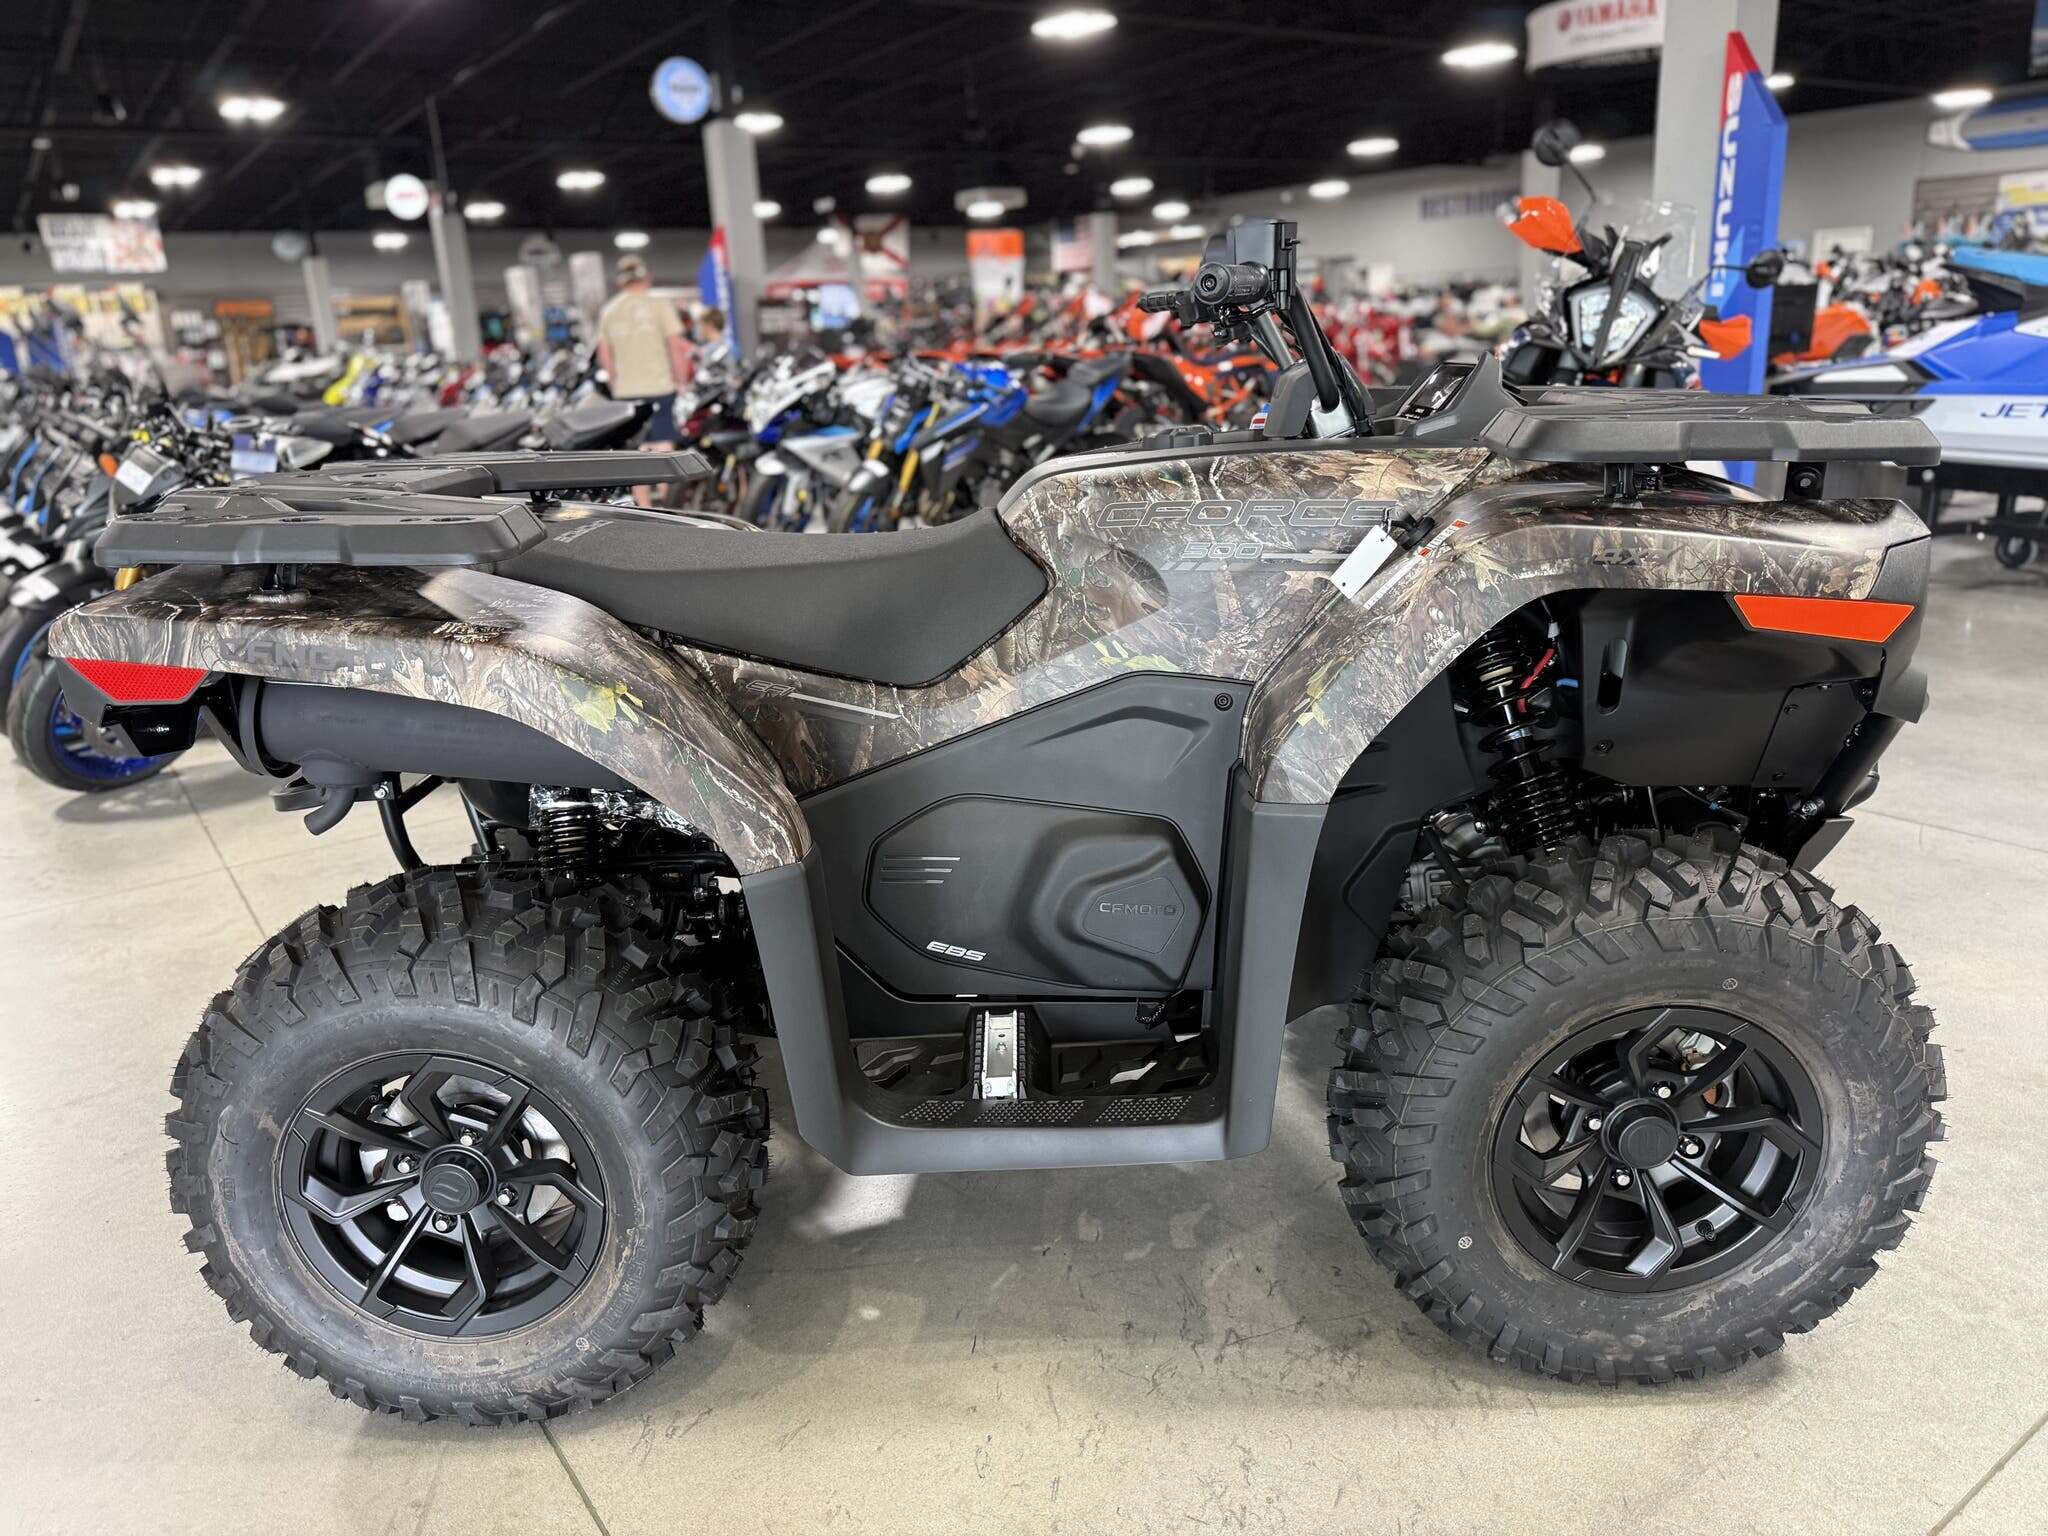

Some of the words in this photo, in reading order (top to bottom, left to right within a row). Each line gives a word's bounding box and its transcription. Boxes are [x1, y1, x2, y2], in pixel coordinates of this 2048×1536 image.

[1711, 71, 1743, 297] SUZUKI
[1096, 499, 1398, 529] CFORCE
[1181, 541, 1264, 560] 500
[1099, 902, 1177, 915] CFMOTO
[926, 940, 987, 961] EBS
